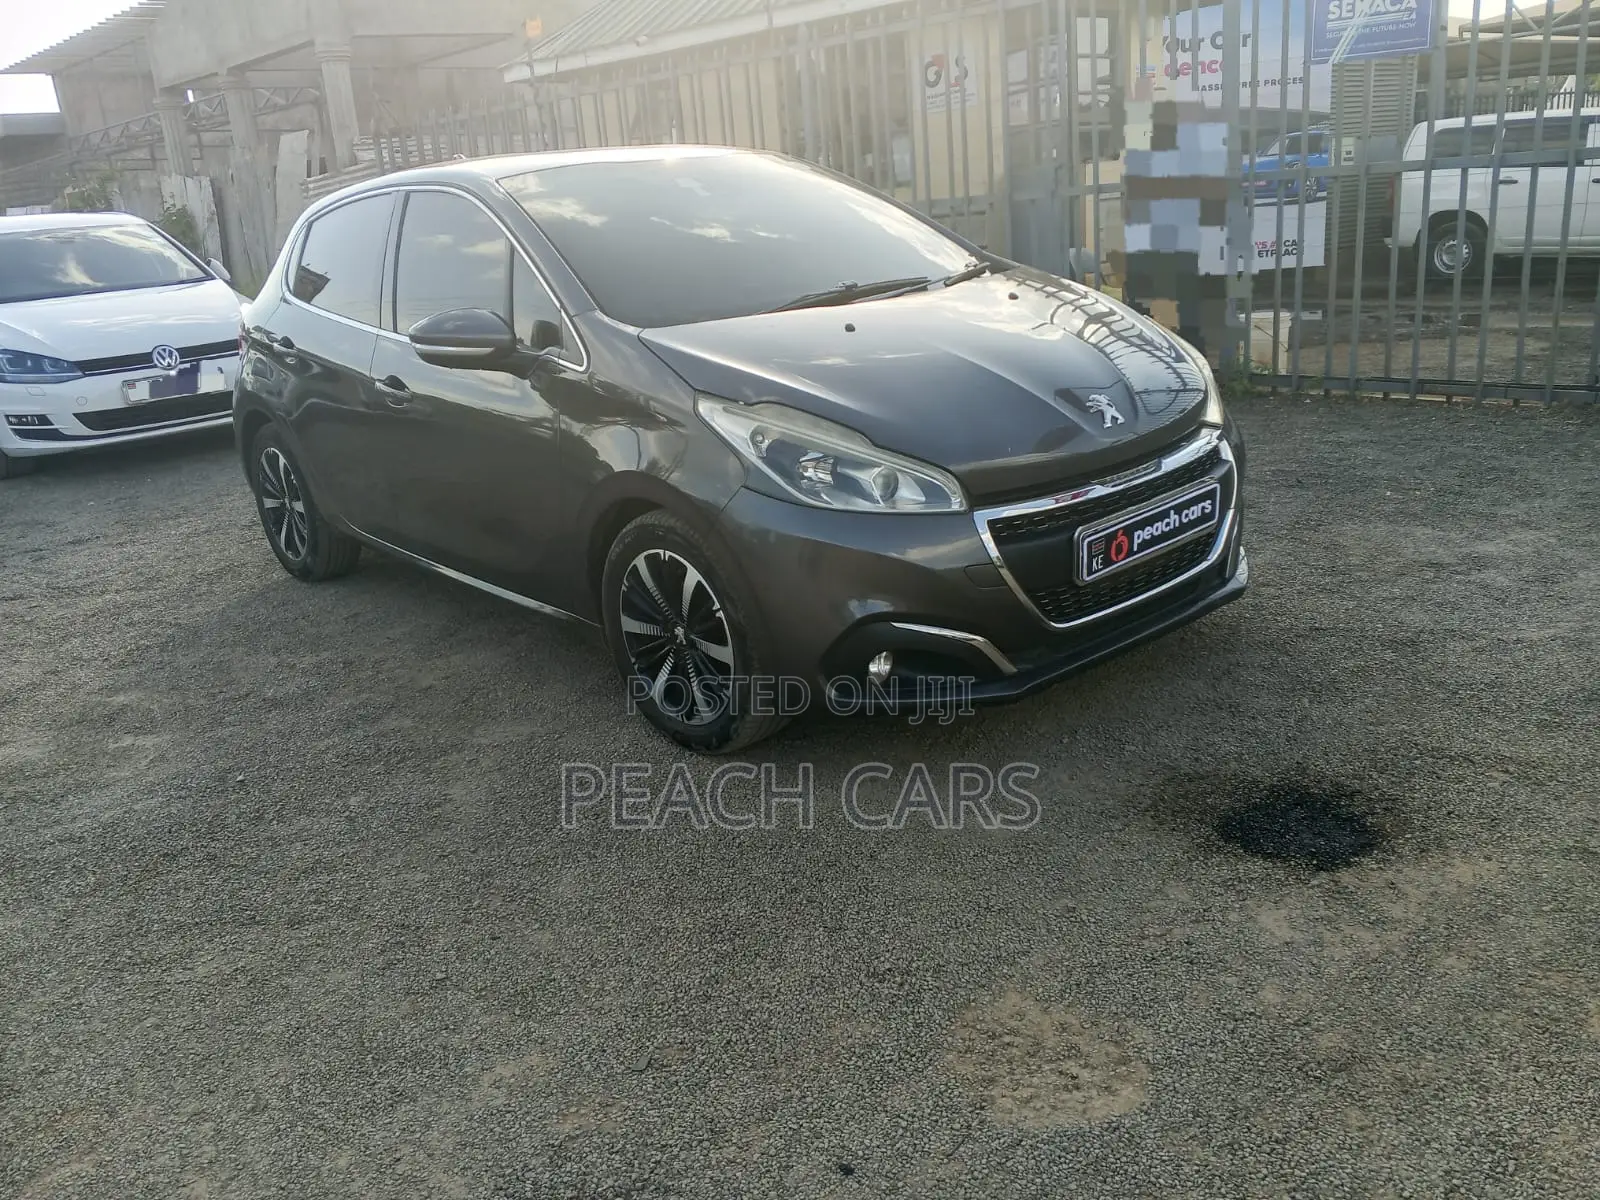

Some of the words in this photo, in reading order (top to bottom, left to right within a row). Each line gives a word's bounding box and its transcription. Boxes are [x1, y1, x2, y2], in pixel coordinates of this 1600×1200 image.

[1210, 30, 1252, 51] Cr
[1133, 510, 1179, 551] peach
[1181, 499, 1212, 524] cars
[1092, 555, 1103, 572] KE
